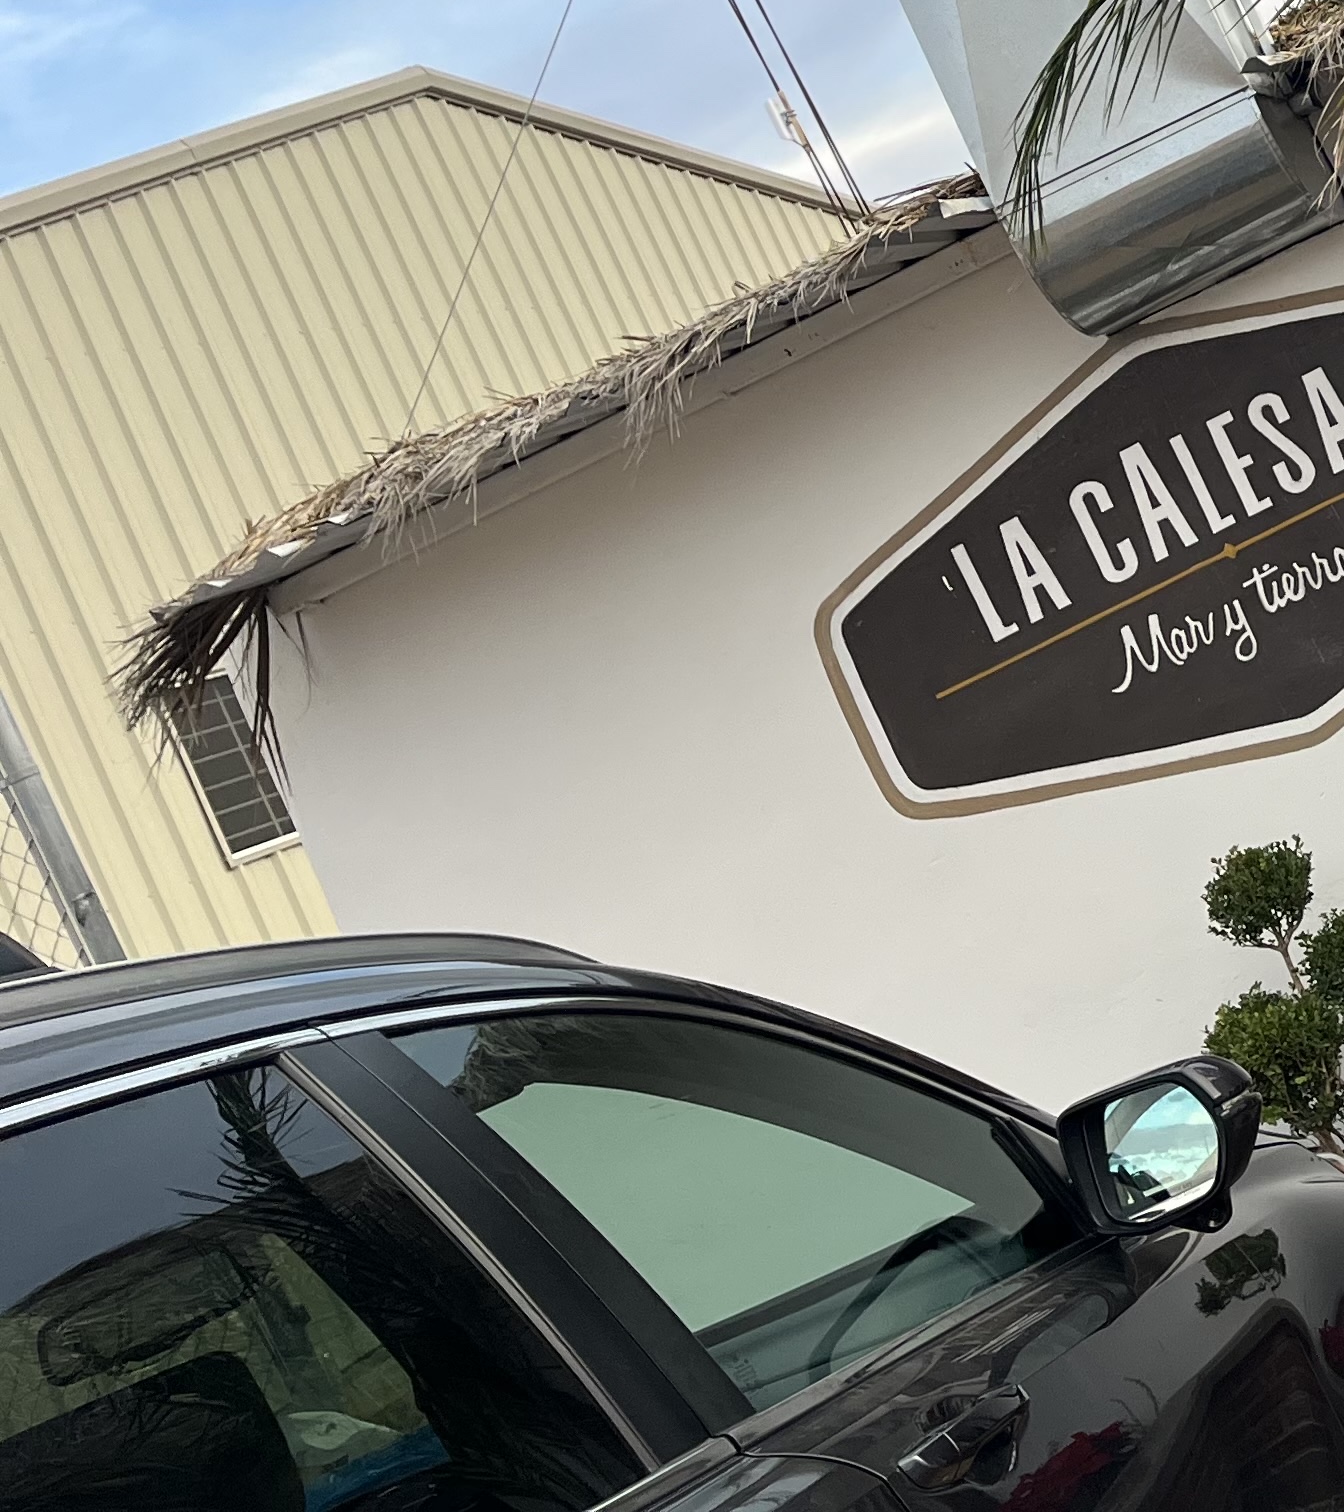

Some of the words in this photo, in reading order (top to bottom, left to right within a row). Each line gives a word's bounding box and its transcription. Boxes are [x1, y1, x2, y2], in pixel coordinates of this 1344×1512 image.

[950, 515, 1073, 643] LA
[1111, 610, 1215, 694] Mar
[1223, 598, 1258, 662] y
